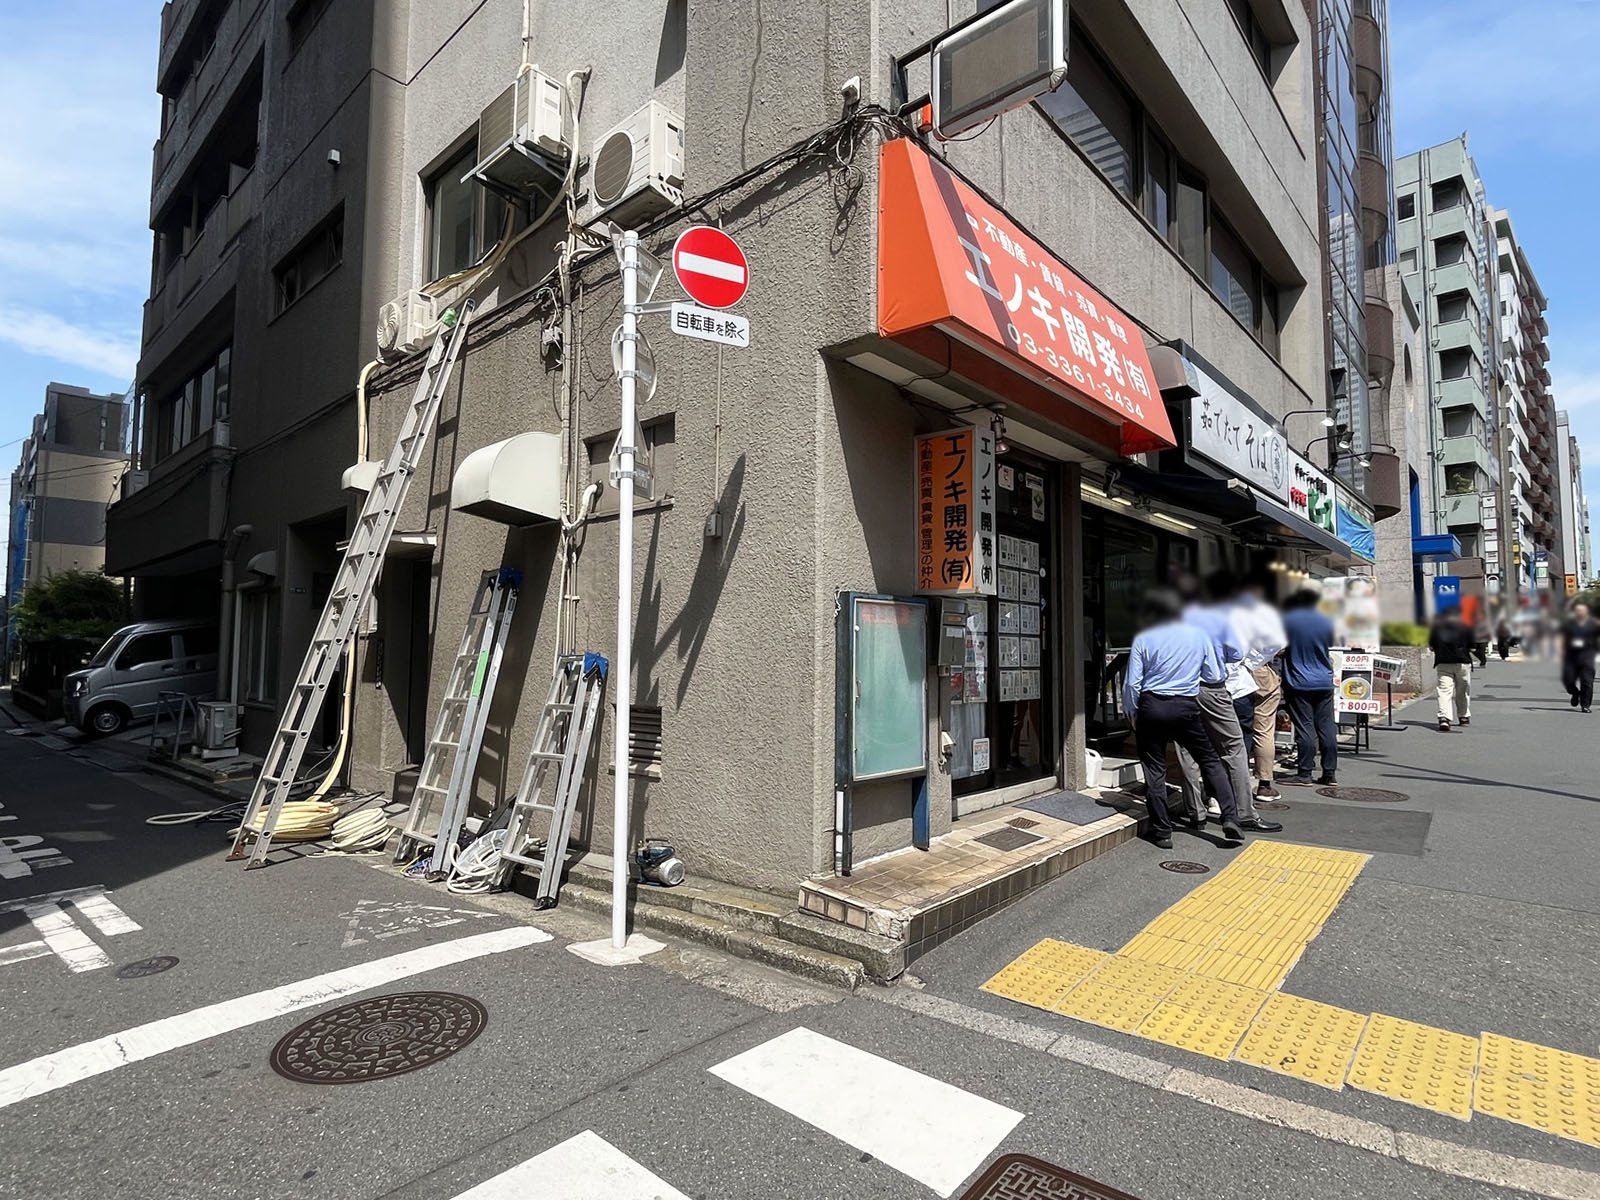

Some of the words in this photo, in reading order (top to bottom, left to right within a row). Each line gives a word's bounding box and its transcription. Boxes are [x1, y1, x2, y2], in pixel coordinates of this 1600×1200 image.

[677, 311, 745, 341] 自転車を除く
[957, 235, 1151, 401] エノキ開発(有)
[1007, 322, 1145, 420] 03-3361-3434
[1200, 398, 1268, 472] 茹でたてそば
[941, 434, 971, 584] エノキ開発(有)
[980, 437, 993, 585] エノキ開発(有)
[1345, 655, 1369, 664] 800円
[1347, 701, 1378, 712] 800円
